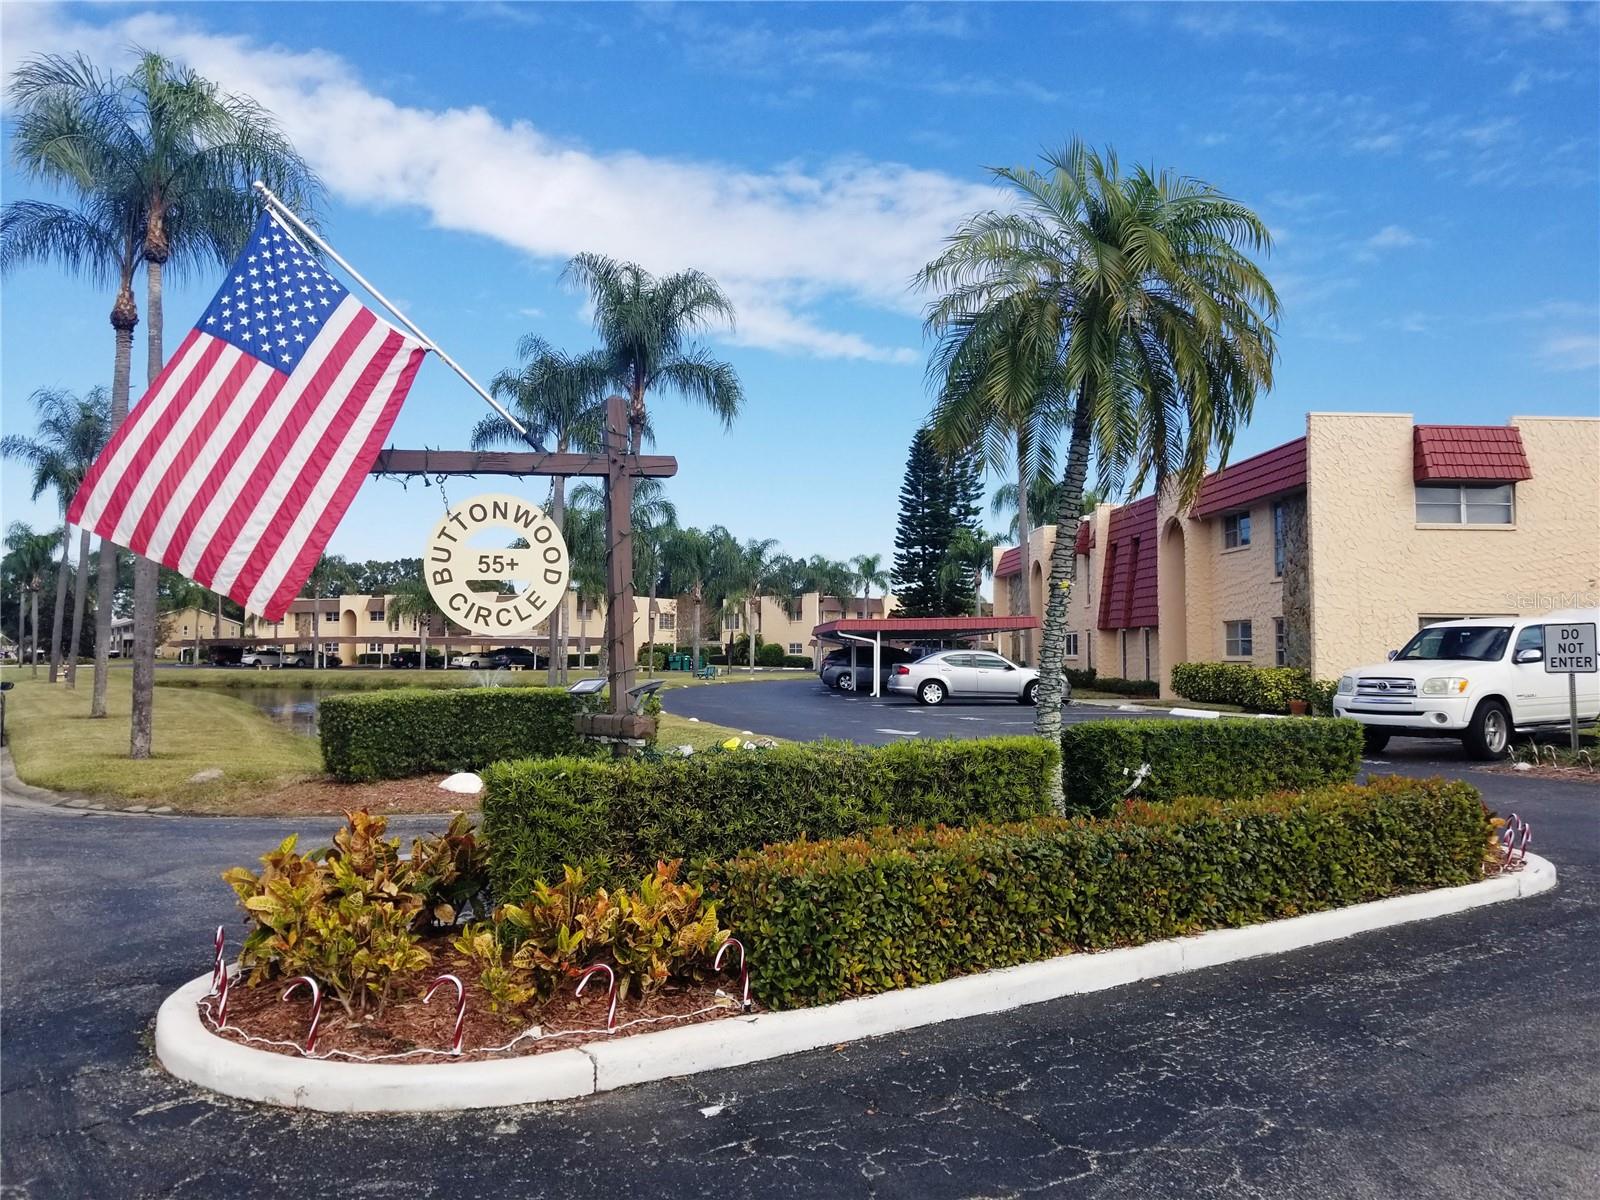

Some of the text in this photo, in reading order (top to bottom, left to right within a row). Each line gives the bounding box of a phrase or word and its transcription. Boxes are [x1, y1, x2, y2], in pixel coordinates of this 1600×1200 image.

[431, 501, 562, 586] BUTTONWOOD
[478, 555, 519, 574] 55+
[448, 590, 547, 627] CIRCLE
[1561, 629, 1579, 640] DO
[1558, 643, 1584, 654] NOT
[1551, 657, 1593, 668] ENTER
